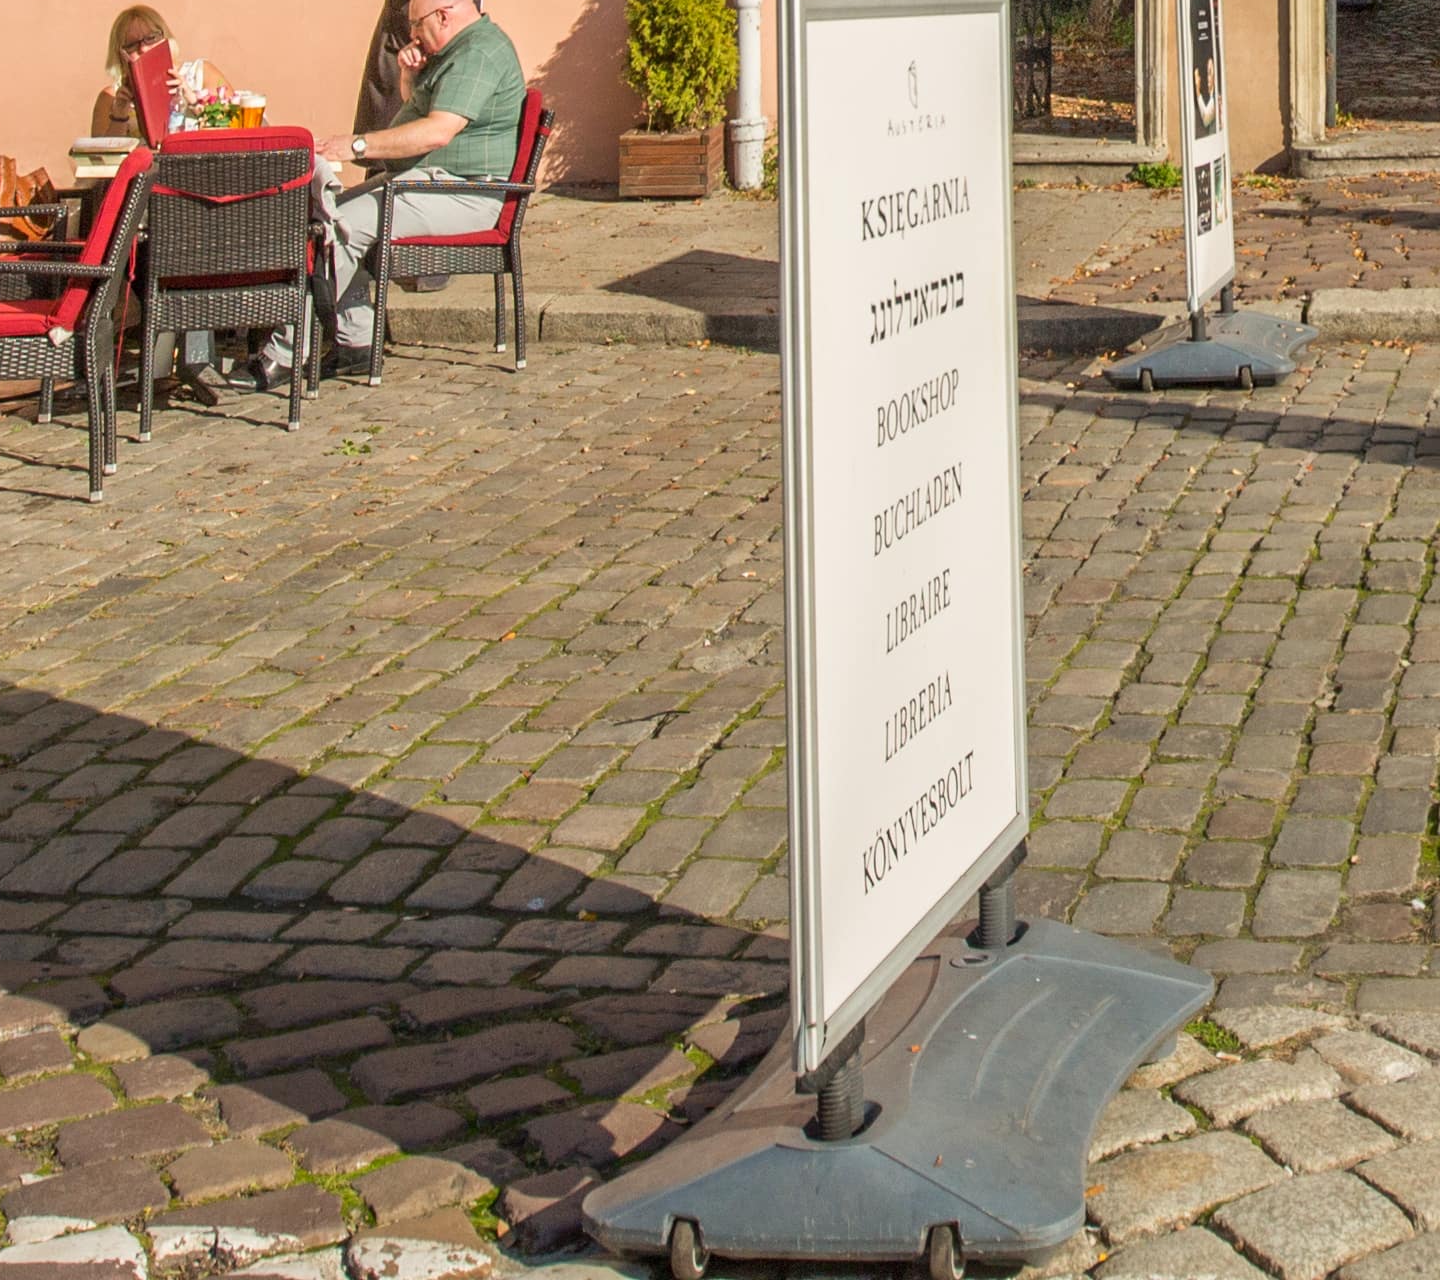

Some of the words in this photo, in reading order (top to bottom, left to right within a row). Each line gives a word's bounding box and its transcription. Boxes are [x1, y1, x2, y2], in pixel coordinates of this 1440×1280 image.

[861, 175, 970, 241] KSIĘGARNIA
[870, 271, 965, 345] בוכהאנדלונג
[877, 368, 959, 448] BOOKSHOP
[874, 462, 962, 557] BUCHLADEN
[885, 567, 950, 655] LIBRAIRE
[885, 669, 952, 763] LIBRERIA
[862, 750, 974, 896] KÖNYVESBOLT
